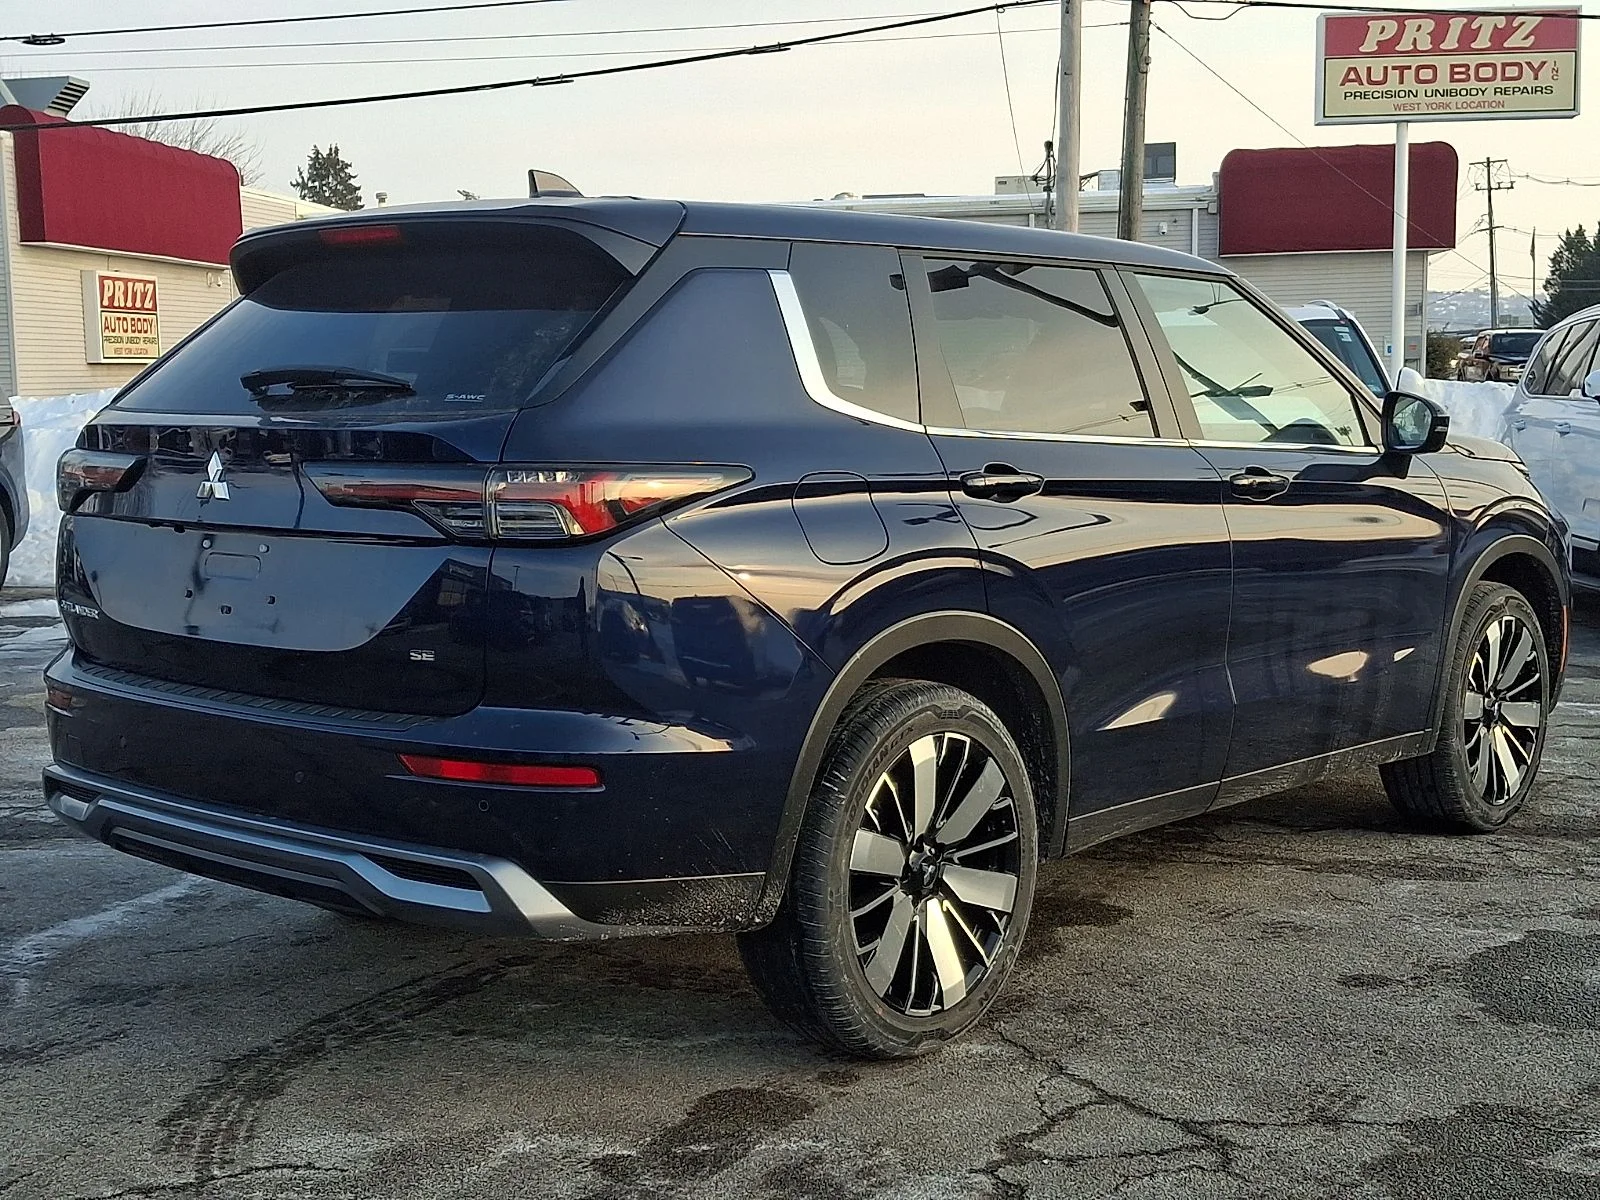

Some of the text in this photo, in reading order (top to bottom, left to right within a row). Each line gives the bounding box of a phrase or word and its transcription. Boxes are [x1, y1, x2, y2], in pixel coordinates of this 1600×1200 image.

[1358, 16, 1544, 52] PRITZ
[1339, 60, 1548, 87] AUTO BODY
[1344, 85, 1554, 100] PRECISION UNIBODY REPAIRS
[1393, 100, 1505, 112] WEST YORK LOCATION
[102, 280, 154, 309] PRITZ
[103, 316, 128, 333] AUTO
[130, 317, 154, 334] BODY
[410, 649, 435, 661] SE
